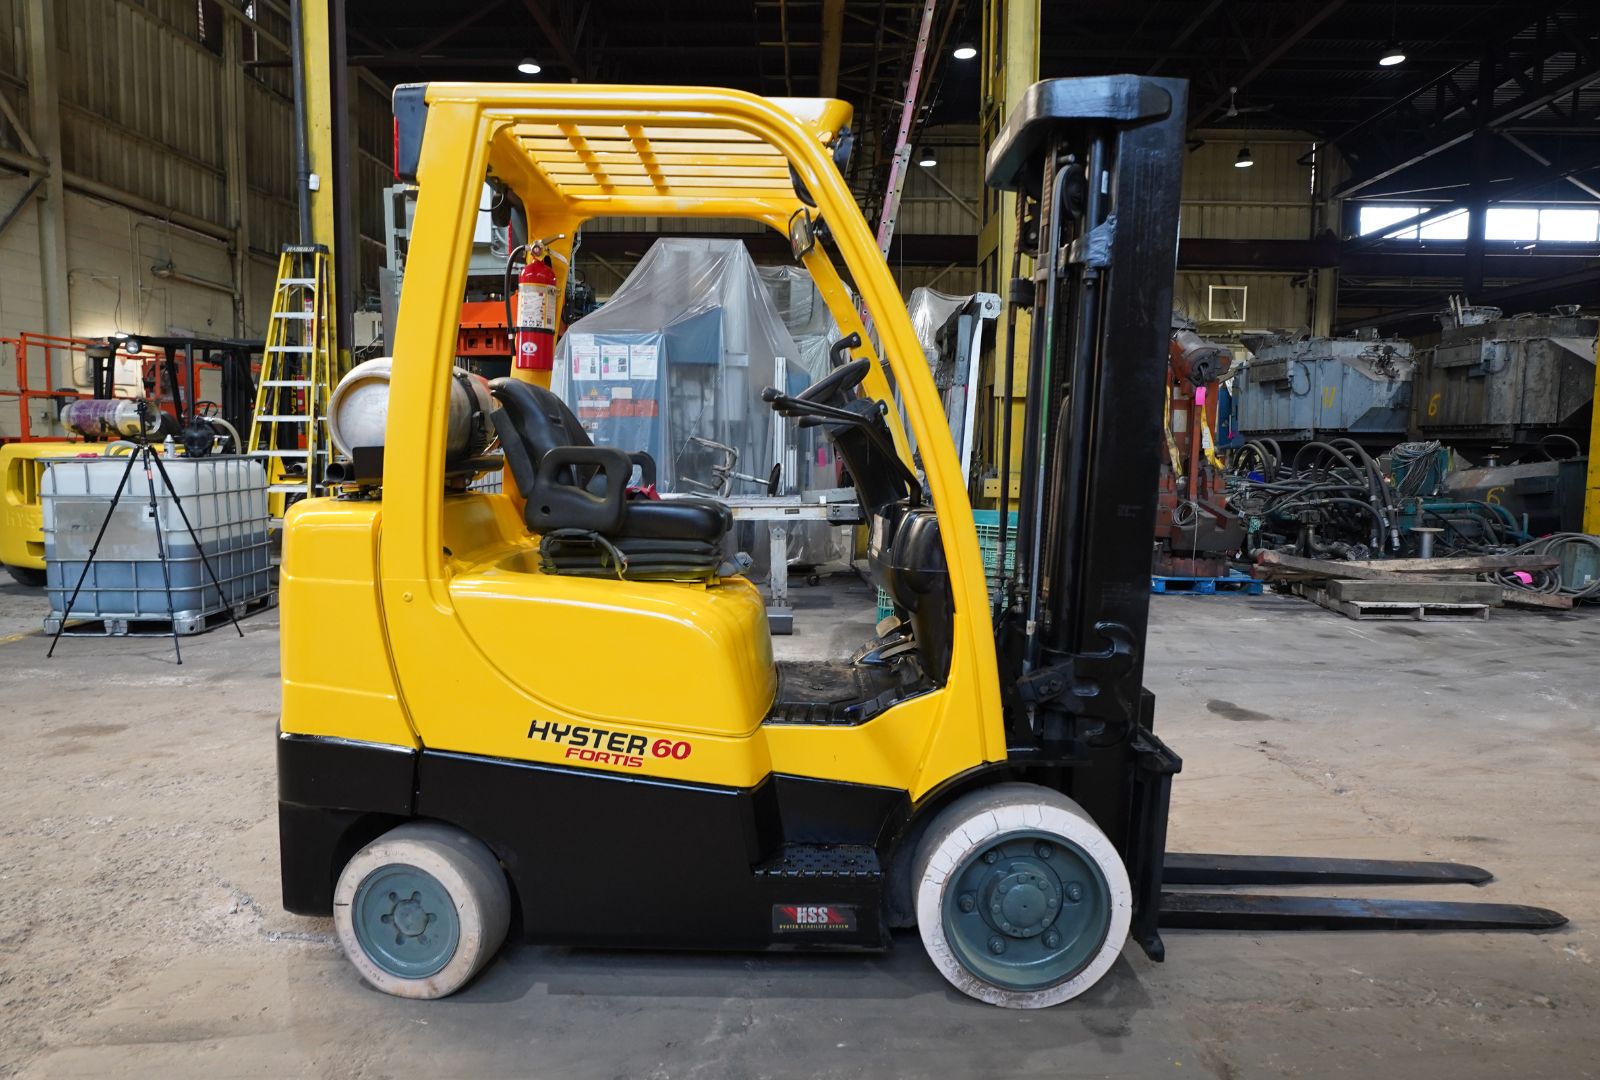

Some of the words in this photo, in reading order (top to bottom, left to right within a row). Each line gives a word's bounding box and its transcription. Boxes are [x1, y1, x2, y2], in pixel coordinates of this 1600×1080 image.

[1428, 392, 1441, 417] 6
[1487, 486, 1505, 505] 6
[527, 719, 648, 756] HYSTER
[651, 739, 692, 761] 60
[565, 748, 644, 768] FORTIS
[796, 906, 829, 923] HSS
